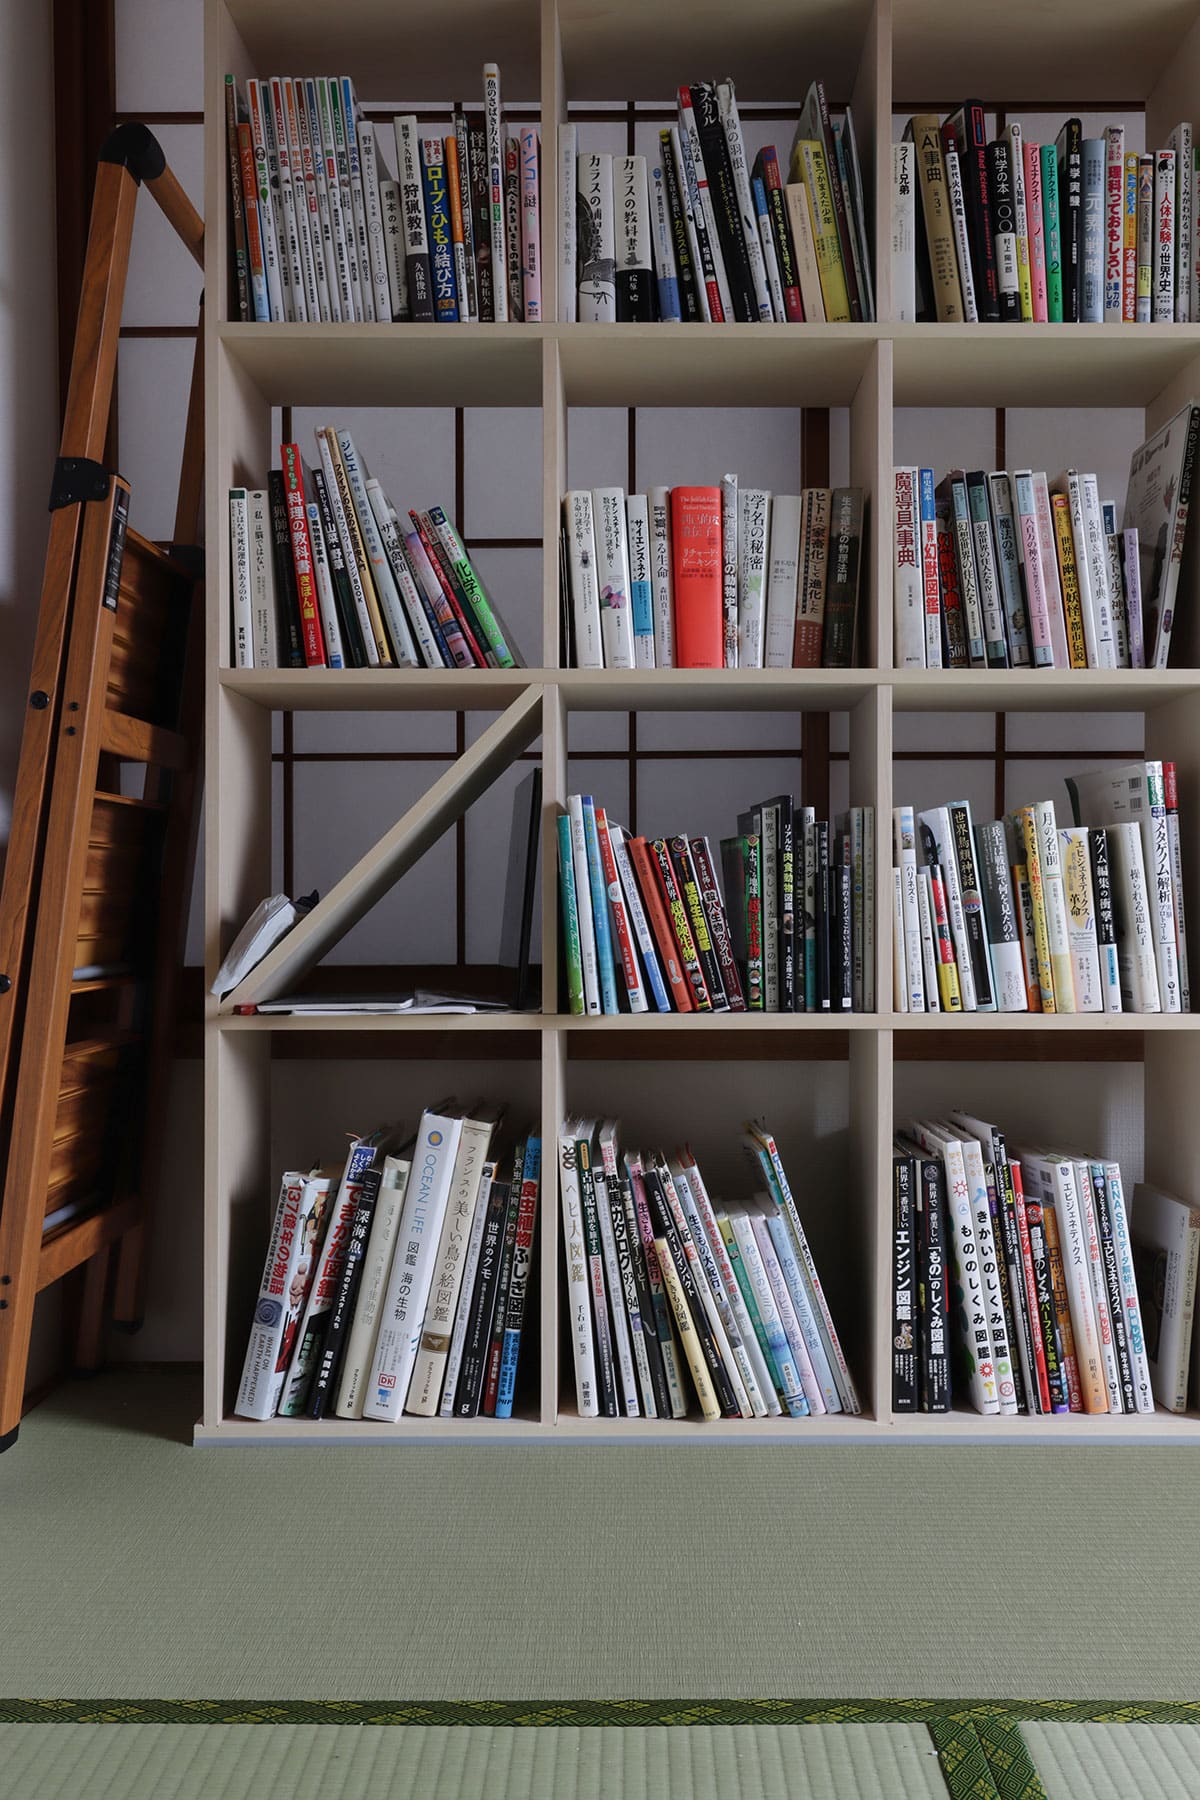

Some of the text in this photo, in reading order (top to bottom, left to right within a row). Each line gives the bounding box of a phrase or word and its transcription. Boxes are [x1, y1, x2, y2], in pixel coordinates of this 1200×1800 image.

[487, 79, 500, 167] 魚のさばき方大事典
[700, 91, 715, 127] スカル
[727, 120, 745, 169] 鳥の羽根
[315, 151, 324, 175] トンボ
[469, 130, 487, 197] 怪物狩り
[522, 134, 537, 208] インコの謎
[624, 158, 637, 251] カラスの教科書
[812, 151, 832, 225] 風をつかまえた少年
[899, 146, 909, 196] ライト兄弟
[949, 154, 964, 217] 次世代火力発電
[384, 189, 398, 236] 標本の本
[402, 183, 423, 248] 狩猟教書
[427, 166, 453, 299] ロープとひもの結び方
[589, 155, 602, 263] カラスの補習授業
[1085, 192, 1099, 276] 元素戦略
[1107, 166, 1122, 281] 理科っておもしろい
[1160, 192, 1171, 293] 人体実験の世界史
[415, 262, 427, 300] 久保俊治
[288, 491, 309, 574] 料理の教科書
[654, 506, 668, 579] 計算する生命
[750, 494, 765, 571] 学名の秘密
[836, 496, 851, 584] 生命進化の物理法則
[895, 472, 915, 568] 魔導具事典
[1000, 517, 1015, 562] 魔法の薬
[957, 521, 977, 607] 幻想世界の住人たち
[1060, 535, 1084, 662] 世界の幽霊・妖怪・都市伝説
[1107, 536, 1125, 622] 図解クトゥルフ神話
[949, 646, 966, 659] 500
[1042, 813, 1058, 866] 月の名前
[1076, 840, 1090, 916] エピジェネティクス
[1095, 830, 1112, 923] ゲノム編集の衝撃
[1156, 819, 1171, 902] メタゲノム解析
[765, 811, 778, 987] 世界で一番美しいイカとタコの図鑑
[906, 866, 915, 904] ハリネズミ
[992, 826, 1014, 942] 兵士は戦場で何を見たのか
[1070, 893, 1081, 917] 革命
[348, 1209, 371, 1255] 深海魚
[410, 1154, 437, 1235] OCEAN LIFE
[432, 1146, 474, 1324] フランスの美しい鳥の絵図鑑
[506, 1157, 524, 1246] 食虫植物のわな
[565, 1184, 584, 1283] ヘビ大図鑑
[606, 1175, 631, 1271] 競馬カタログ
[1063, 1184, 1082, 1265] エピジェネティクス
[269, 1186, 303, 1296] 137億年の物語
[316, 1186, 361, 1298] できかた図鑑
[394, 1241, 420, 1321] 図鑑 海の生物
[481, 1222, 500, 1280] 世界のクモ
[507, 1181, 538, 1330] 食虫植物ふしぎ図鑑
[895, 1230, 911, 1321] エンジン図鑑
[1049, 1247, 1068, 1315] ロボット工学
[1104, 1240, 1121, 1315] エピジェネティクス
[928, 1246, 945, 1356] 「もの」のしくみ図鑑
[961, 1225, 990, 1359] もののしくみ図鑑
[977, 1211, 1008, 1358] きかいのしくみ図鑑
[1030, 1227, 1058, 1370] 自動車のしくみ パーフェクト事典
[380, 1376, 395, 1386] DK
